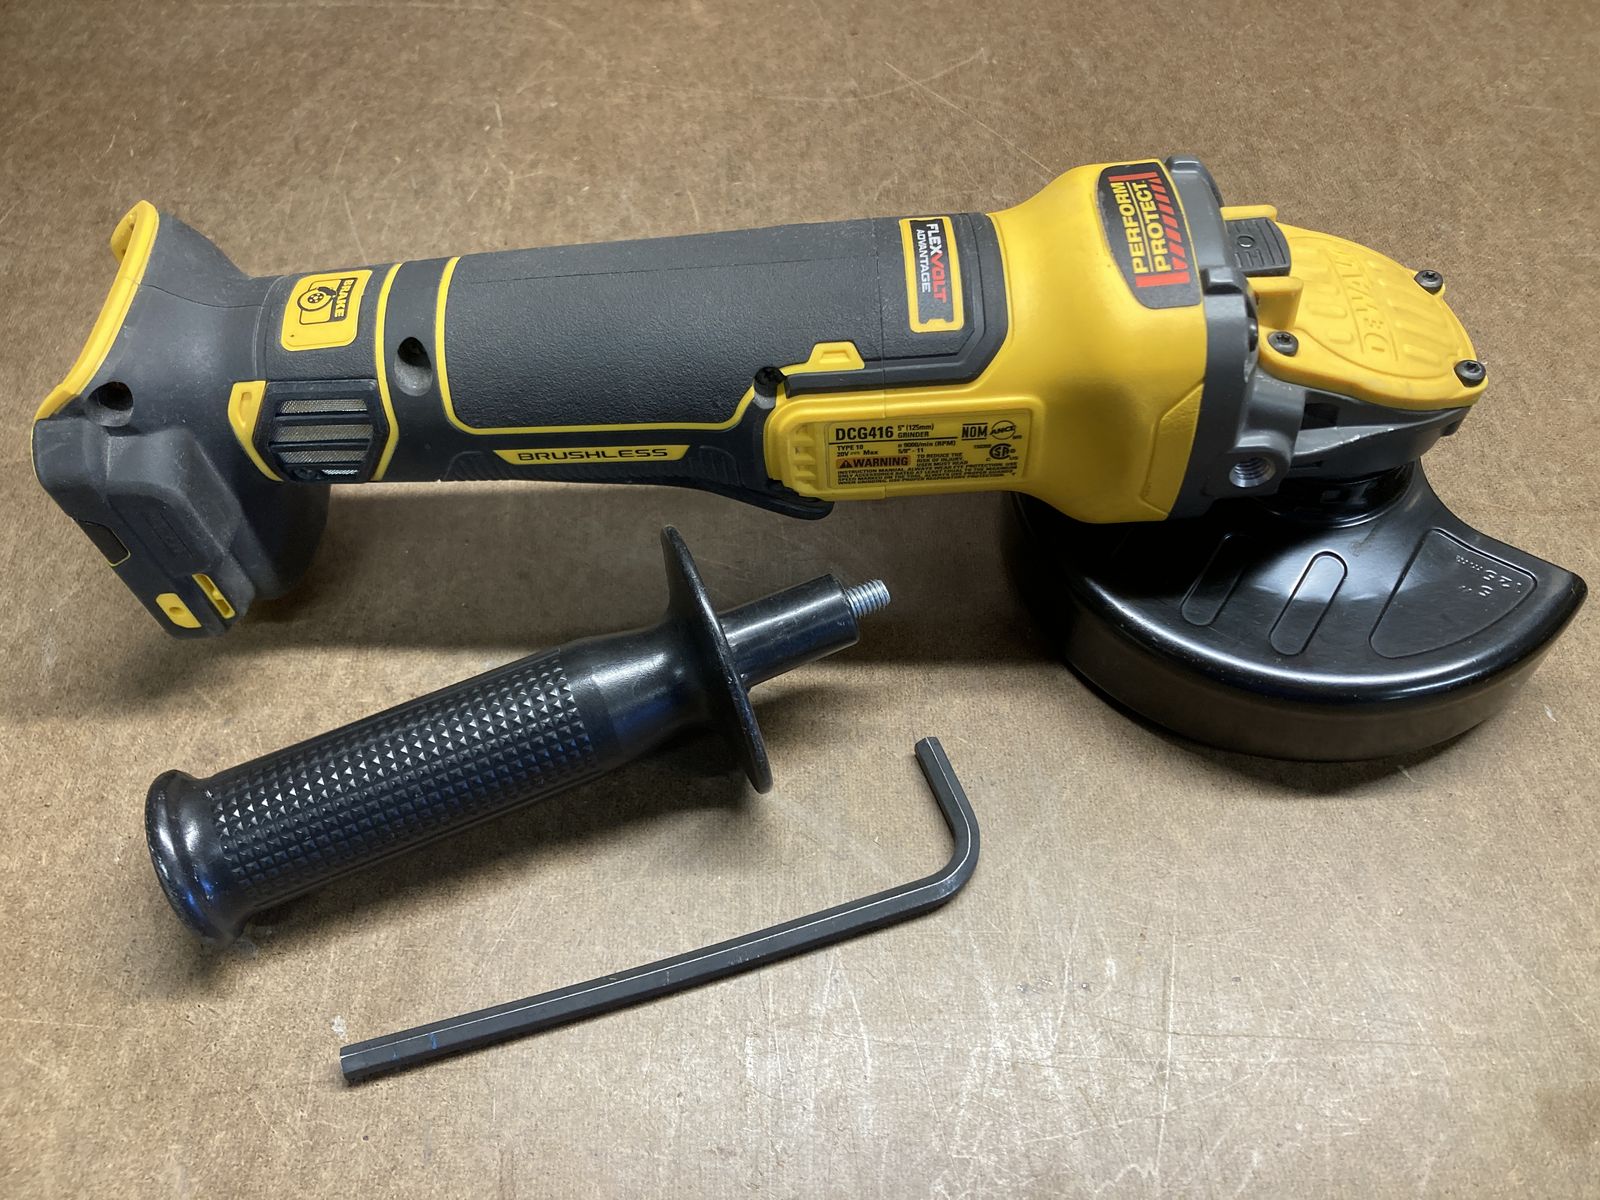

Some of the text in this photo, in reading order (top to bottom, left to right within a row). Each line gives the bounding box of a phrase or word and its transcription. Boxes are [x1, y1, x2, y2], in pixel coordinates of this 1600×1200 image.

[1110, 181, 1149, 274] PERFORM
[916, 229, 931, 293] ADVANTAGE
[926, 223, 947, 304] FLEXVOLT
[334, 279, 354, 318] BRAKE
[835, 426, 894, 441] DCG416
[906, 423, 934, 432] (125mm)
[962, 425, 988, 438] NOM
[898, 431, 929, 439] GRINDER
[518, 448, 668, 461] BRUSHLESS
[853, 457, 908, 468] WARNING
